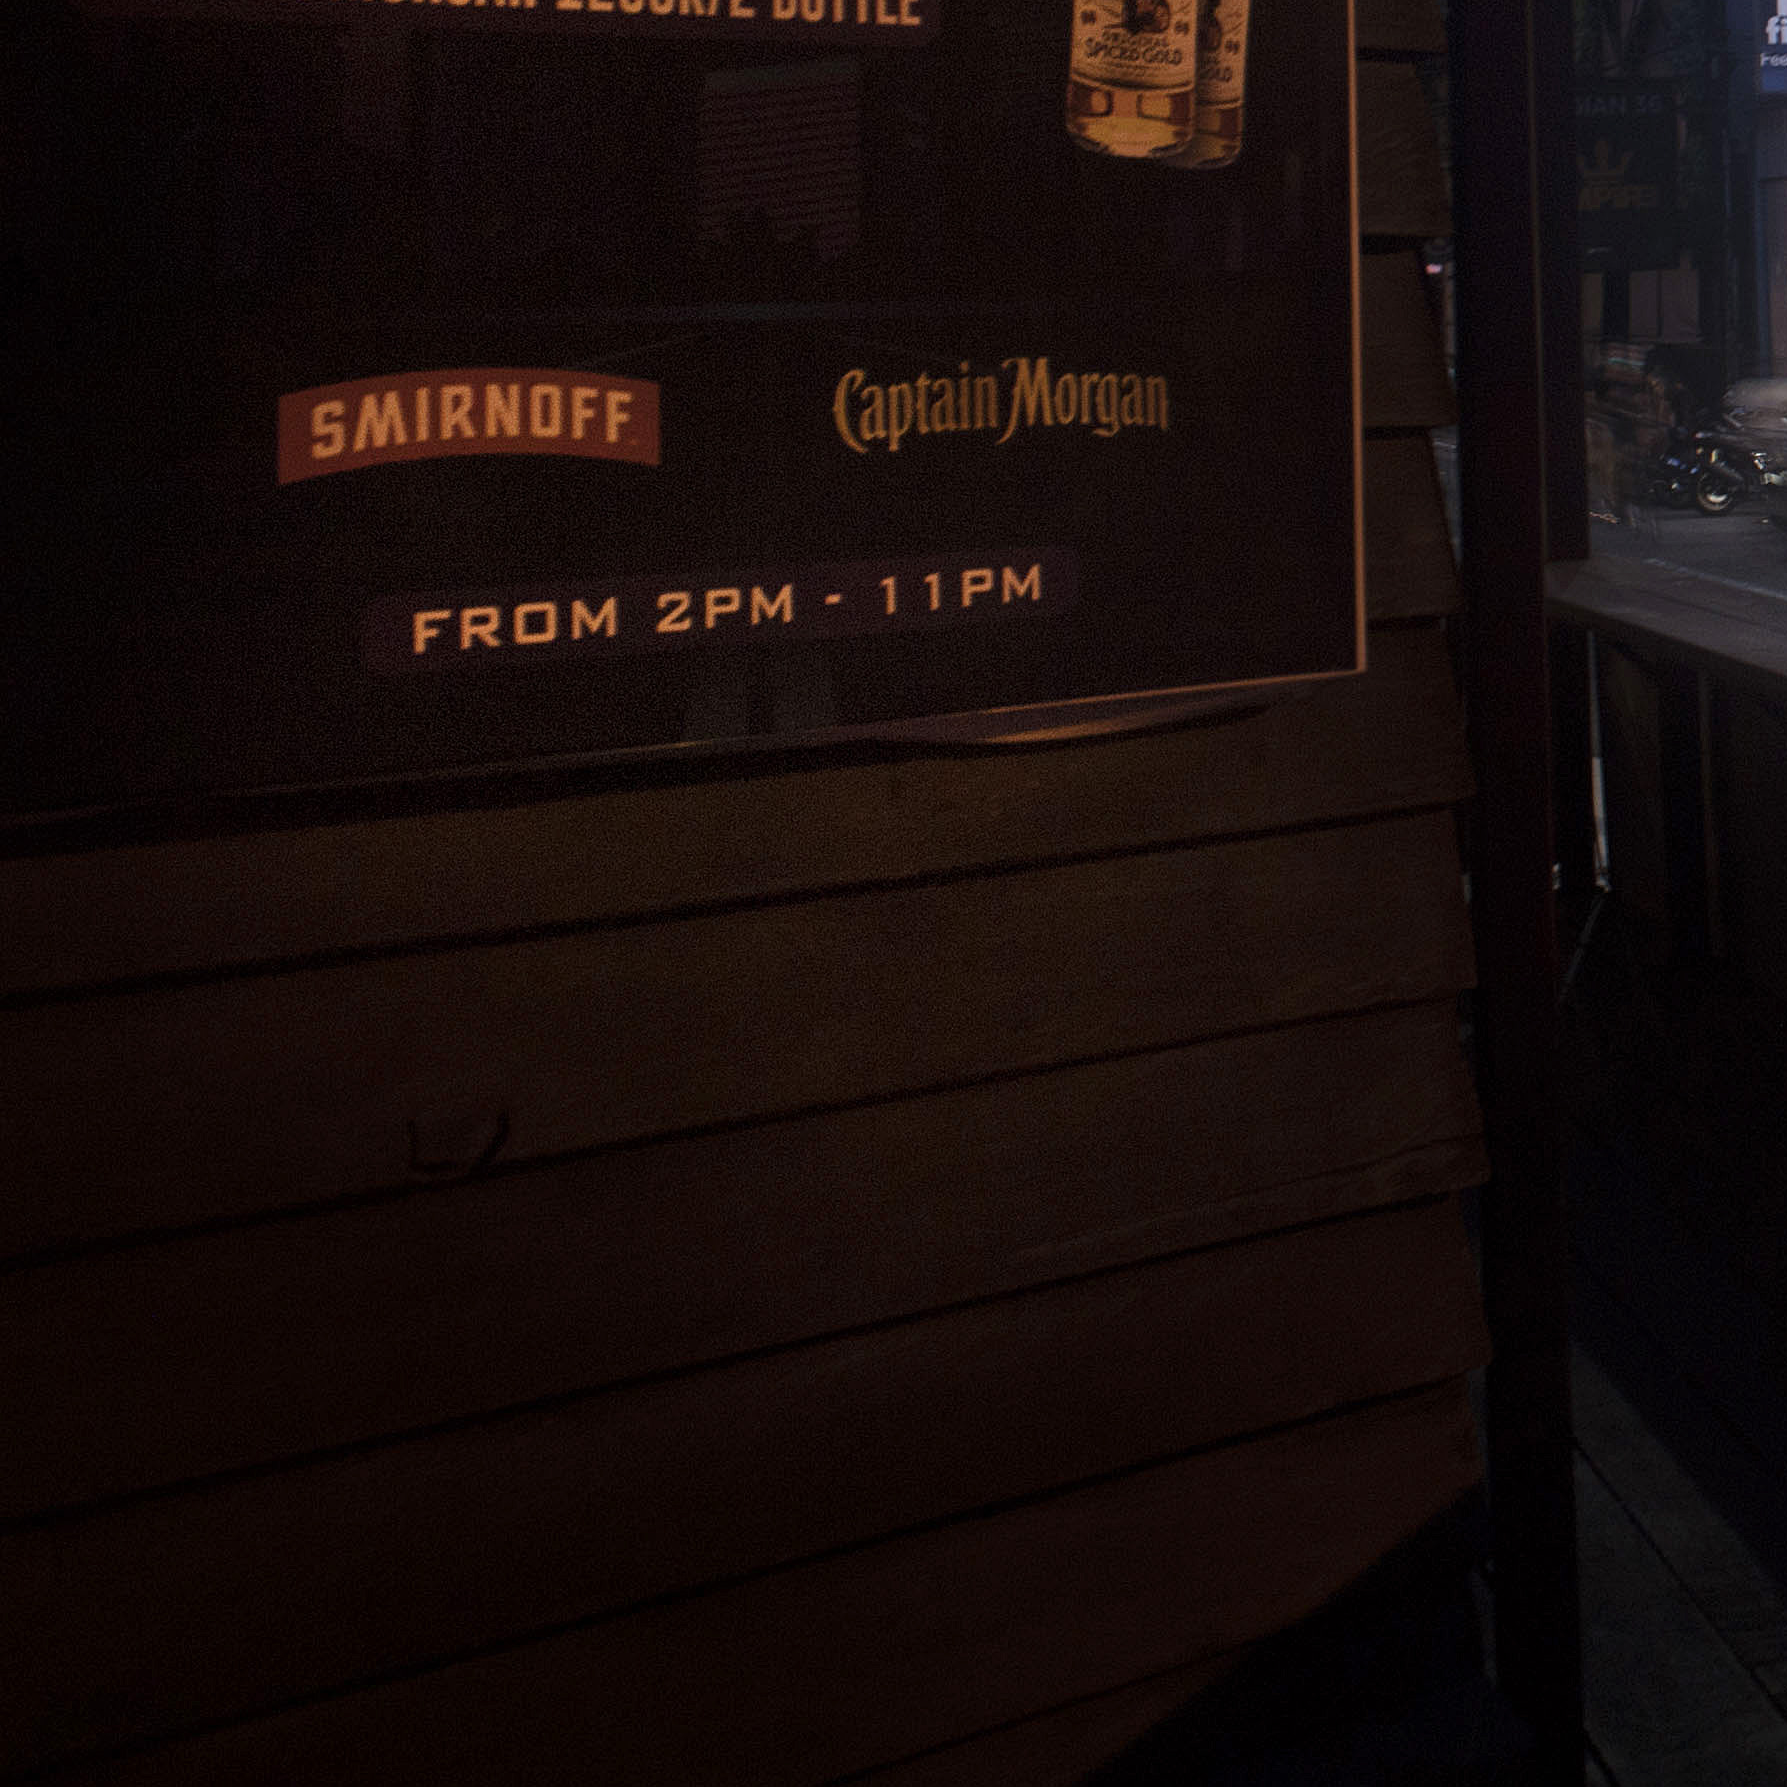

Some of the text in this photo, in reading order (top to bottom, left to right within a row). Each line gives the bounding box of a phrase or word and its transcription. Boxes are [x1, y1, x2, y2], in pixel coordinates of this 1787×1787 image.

[311, 383, 634, 461] SMIRNOFF
[832, 356, 1170, 454] Captain Morgan
[412, 596, 620, 655] FROM
[655, 582, 795, 635] 2PM
[880, 562, 1042, 616] 11PM
